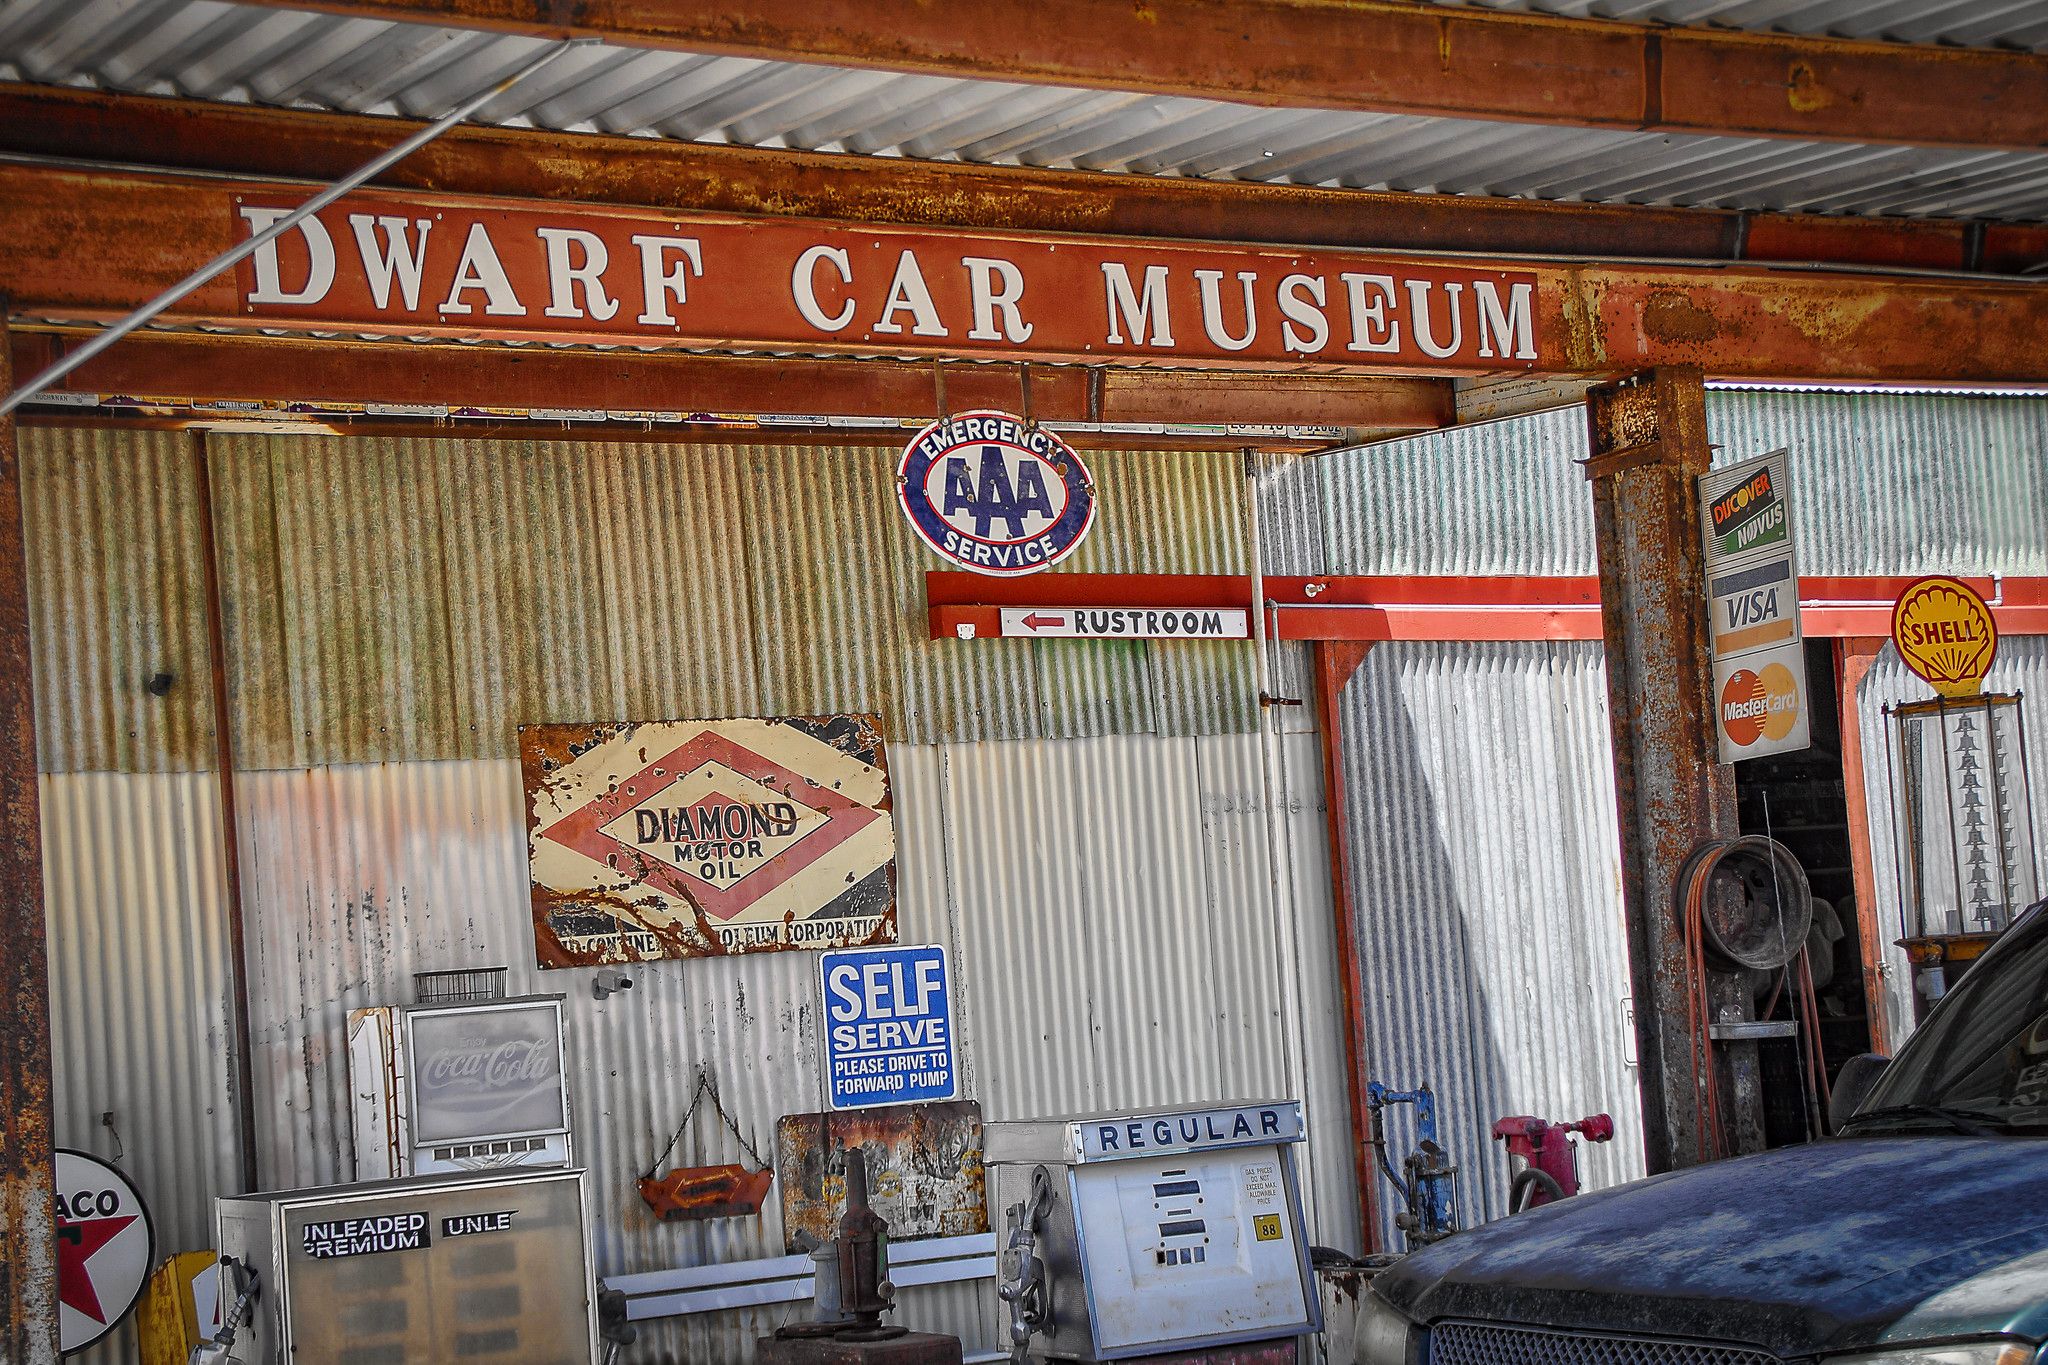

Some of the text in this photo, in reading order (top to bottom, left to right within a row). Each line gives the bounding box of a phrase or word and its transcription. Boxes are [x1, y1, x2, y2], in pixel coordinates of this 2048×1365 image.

[239, 206, 1538, 360] DWARF CAR MUSEUM
[919, 419, 1063, 460] EMERGENCY
[943, 446, 1055, 539] AAA
[1714, 473, 1770, 525] DISCOVER
[1737, 504, 1783, 549] NOVUS
[943, 531, 1058, 567] SERVICE
[1074, 610, 1223, 635] RUSTROOM
[1726, 587, 1779, 629] VISA
[1911, 619, 1979, 646] SHELL
[1724, 691, 1795, 722] MasterCard
[634, 803, 797, 844] DIAMOND
[674, 841, 764, 862] MOTOR
[700, 861, 741, 880] OIL
[829, 960, 941, 1022] SELF
[833, 1018, 946, 1052] SERVE
[422, 1039, 552, 1087] Coca-Cola
[835, 1053, 947, 1077] PLEASE DRIVE TO
[836, 1071, 949, 1095] FORWARD PUMP
[1099, 1110, 1281, 1151] REGULAR
[1246, 1183, 1264, 1191] EXCEED
[1249, 1189, 1277, 1198] ALLOWABLE
[1257, 1197, 1271, 1205] PRICE
[57, 1190, 119, 1218] ACO
[1262, 1224, 1276, 1236] 88
